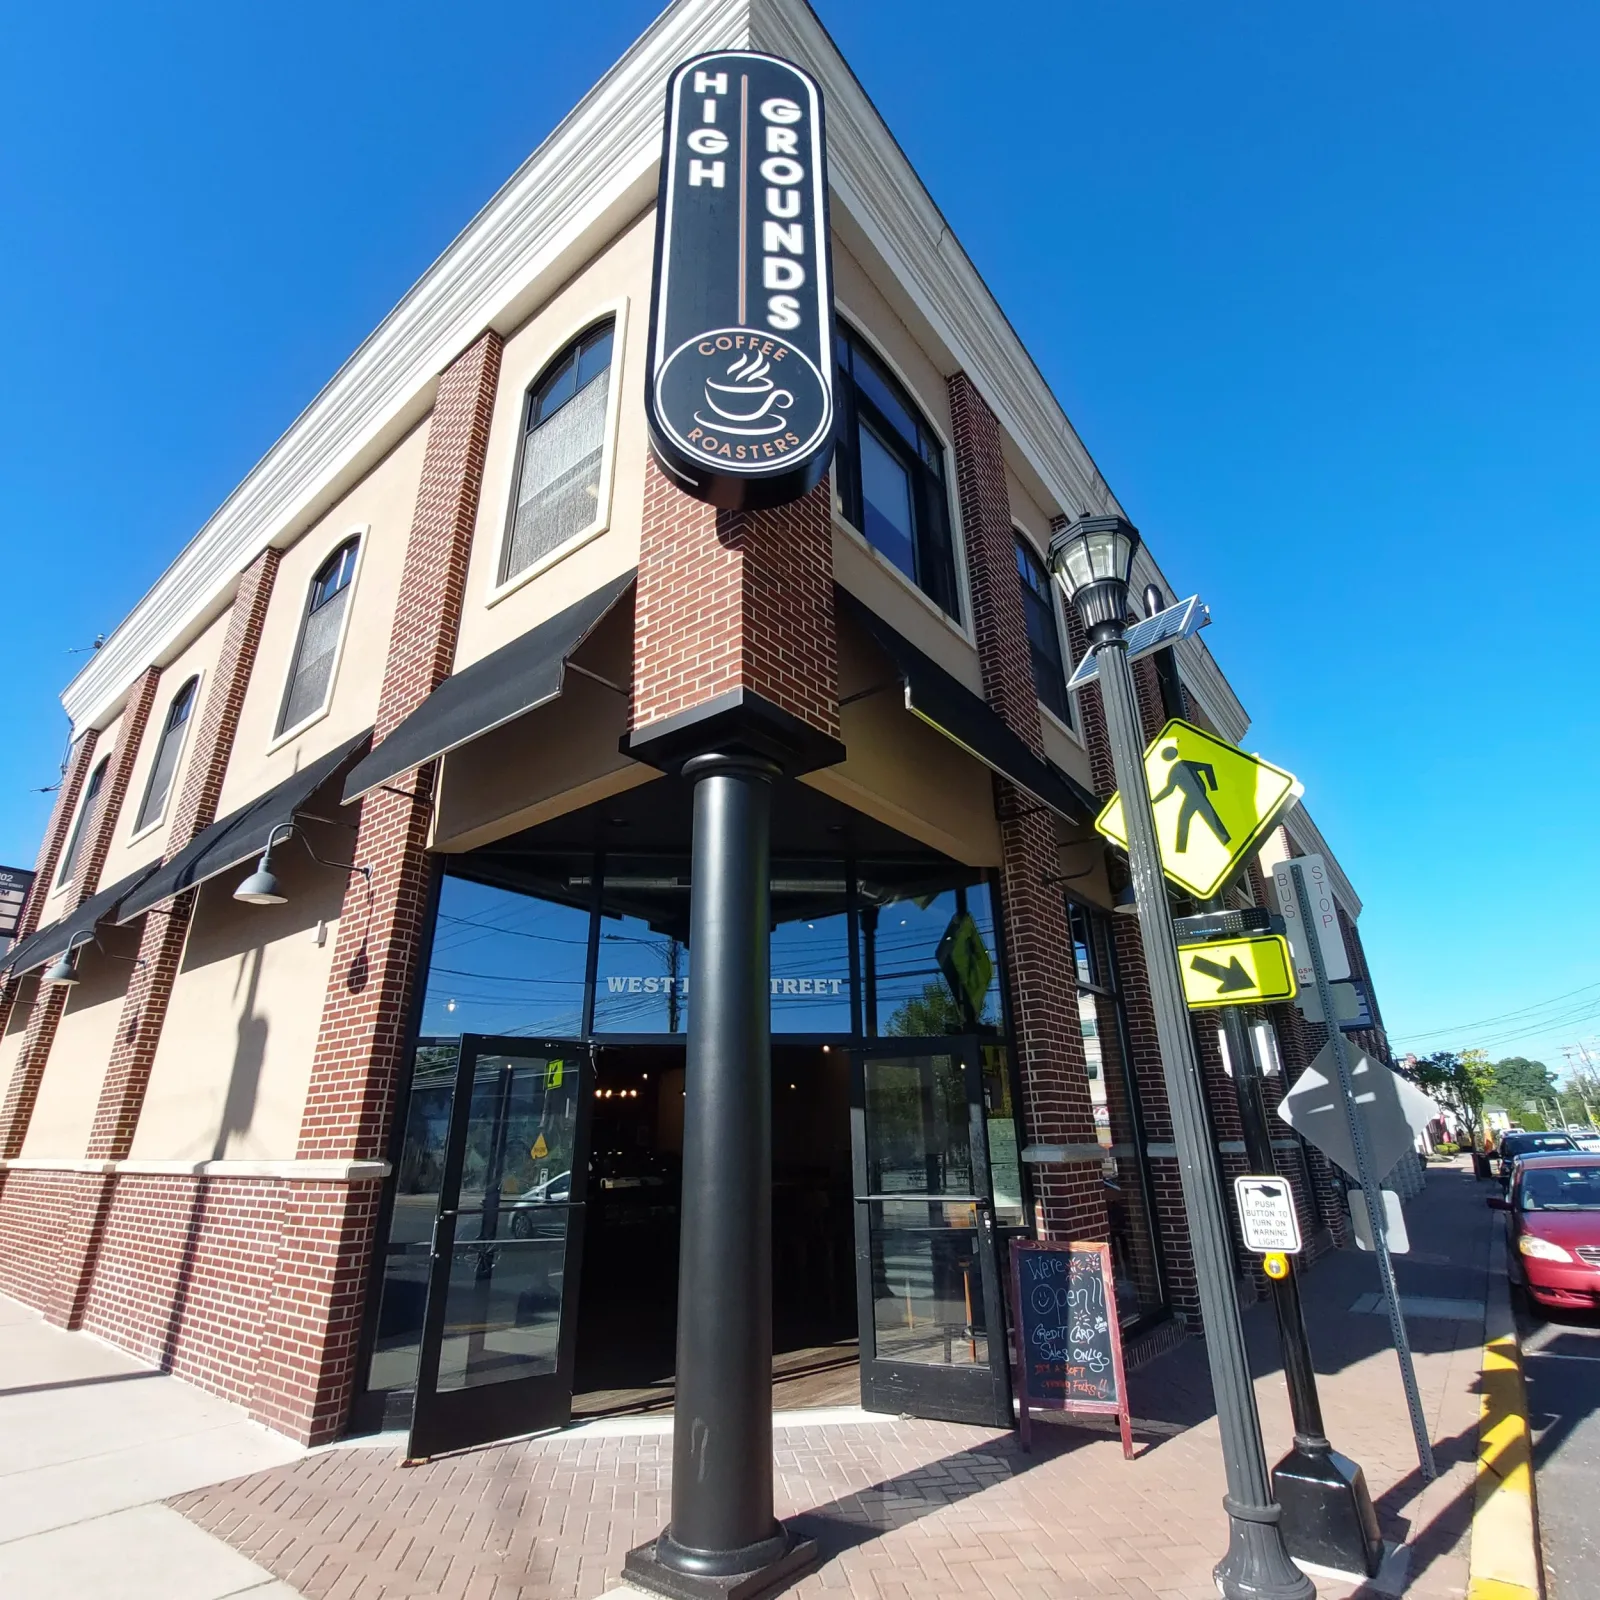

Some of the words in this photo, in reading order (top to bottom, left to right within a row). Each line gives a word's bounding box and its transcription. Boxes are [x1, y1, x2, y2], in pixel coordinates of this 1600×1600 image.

[687, 71, 729, 188] HIGH
[760, 98, 805, 330] GROUNDS
[698, 335, 789, 361] COFFEE
[687, 427, 800, 459] ROASTERS
[1276, 873, 1296, 919] BUS
[1311, 865, 1333, 929] STOP
[607, 977, 675, 993] WEST
[770, 978, 843, 995] TREET
[1245, 1209, 1275, 1217] BUTTON
[1278, 1210, 1288, 1218] TO
[1254, 1200, 1276, 1208] PUSH
[1252, 1228, 1288, 1237] WARNING
[1275, 1219, 1286, 1227] ON
[1258, 1238, 1285, 1246] LIGHTS
